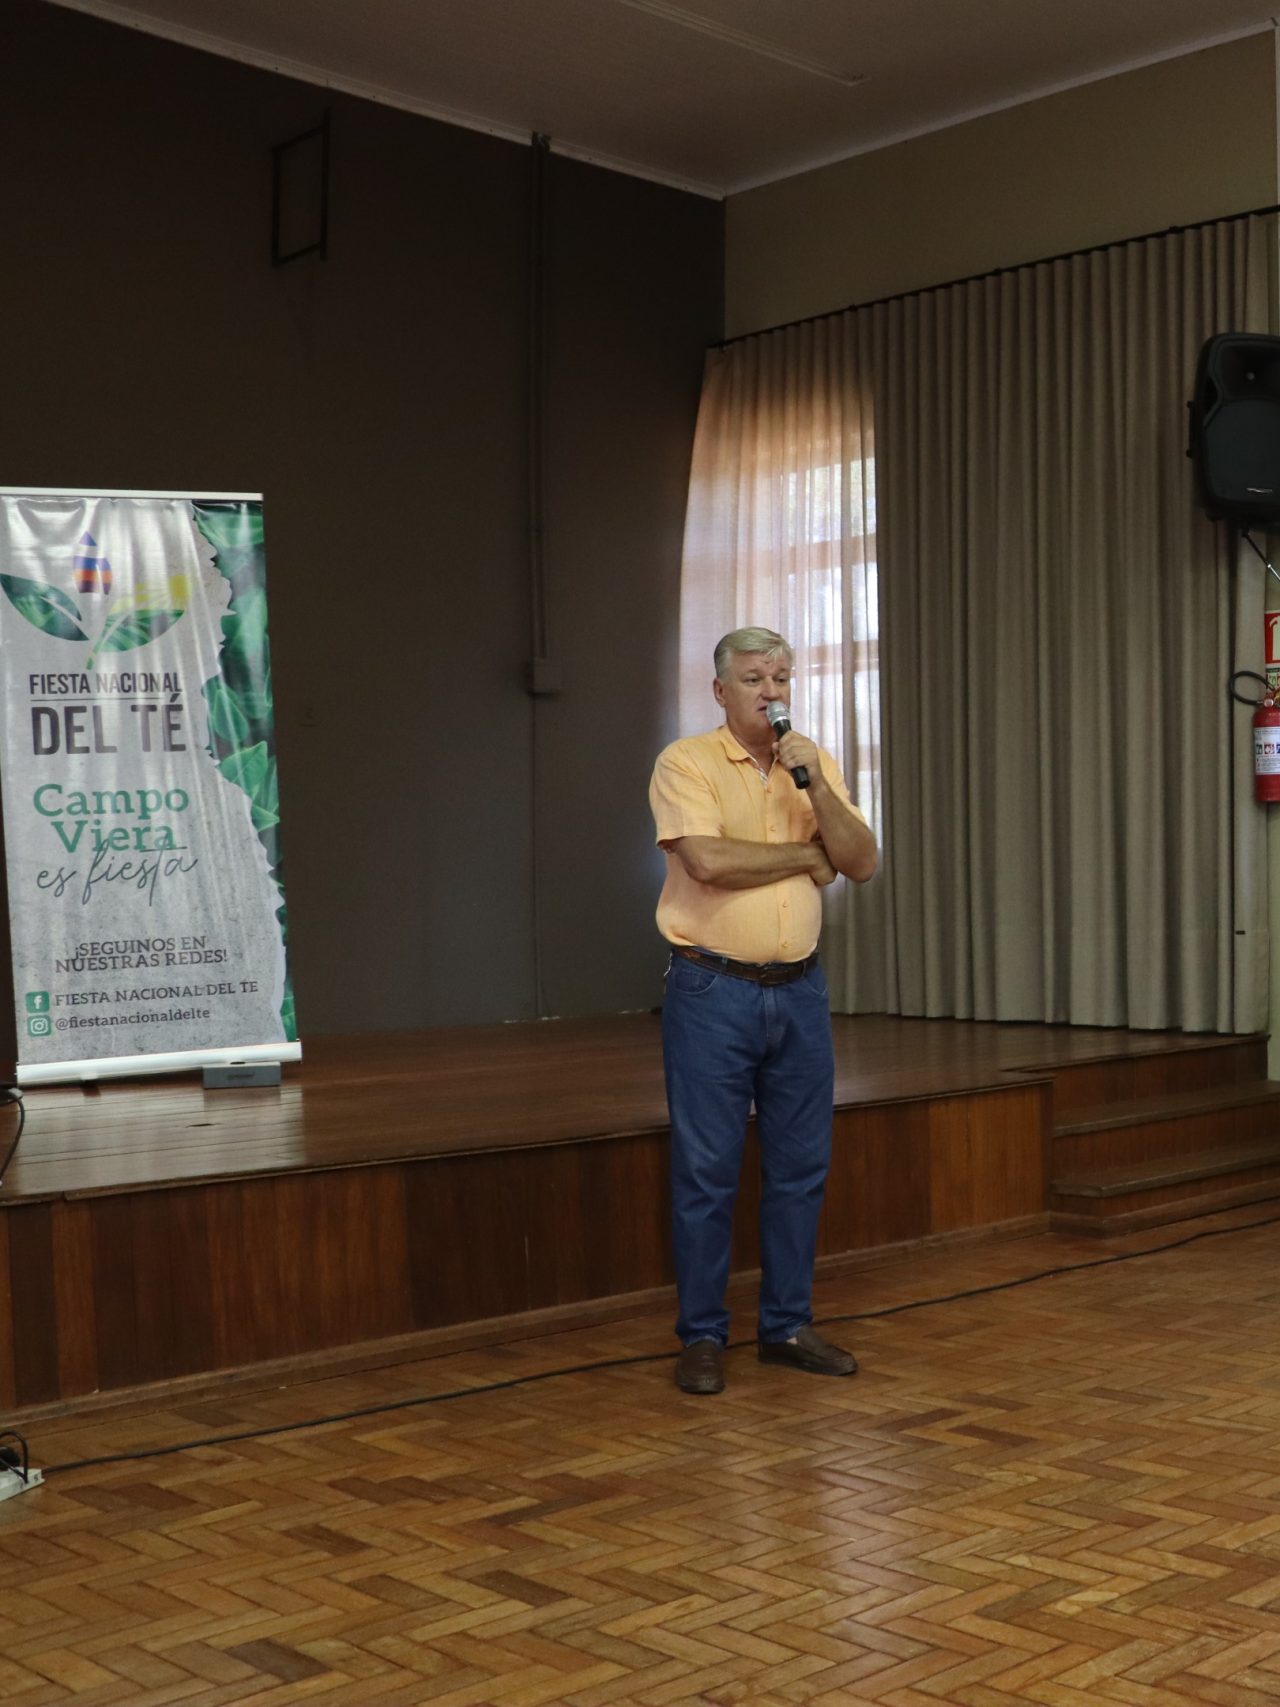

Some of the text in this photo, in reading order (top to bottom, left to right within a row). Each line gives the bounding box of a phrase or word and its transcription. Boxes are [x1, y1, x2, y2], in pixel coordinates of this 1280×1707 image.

[29, 672, 183, 694] FIESTA NACIONAL
[31, 692, 187, 755] DEL TÉ
[33, 783, 189, 820] Campo
[51, 819, 177, 853] Viera
[37, 833, 198, 906] es fiesta
[55, 948, 228, 973] NUESTRAS REDES!
[75, 936, 206, 960] ¡SEGUINOS EN
[55, 981, 258, 1006] FIESTA NACIONAL DEL TE
[55, 1007, 210, 1031] @fiestanacionaldelte
